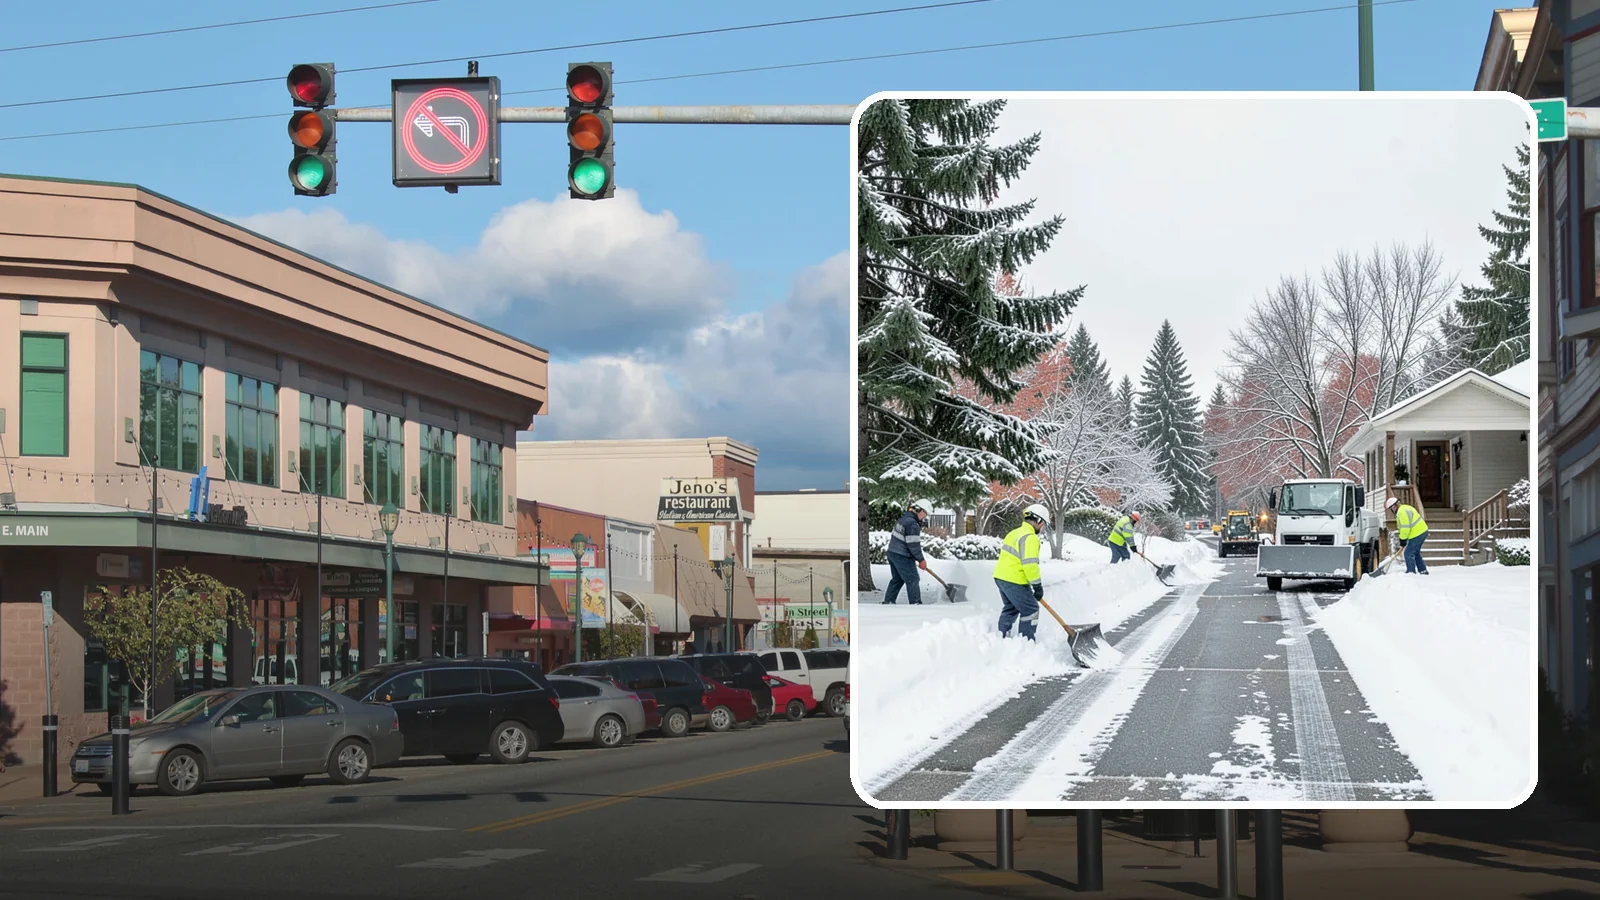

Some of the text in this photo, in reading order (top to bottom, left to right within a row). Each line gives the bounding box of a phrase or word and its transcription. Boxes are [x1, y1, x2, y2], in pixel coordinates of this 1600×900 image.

[670, 480, 727, 494] Jeno's
[665, 496, 731, 509] restaurant
[658, 510, 681, 519] Italian
[686, 509, 714, 519] American
[715, 509, 738, 519] Cuisine
[2, 525, 49, 536] E. MAIN
[797, 607, 828, 617] Street
[791, 619, 823, 627] lass
